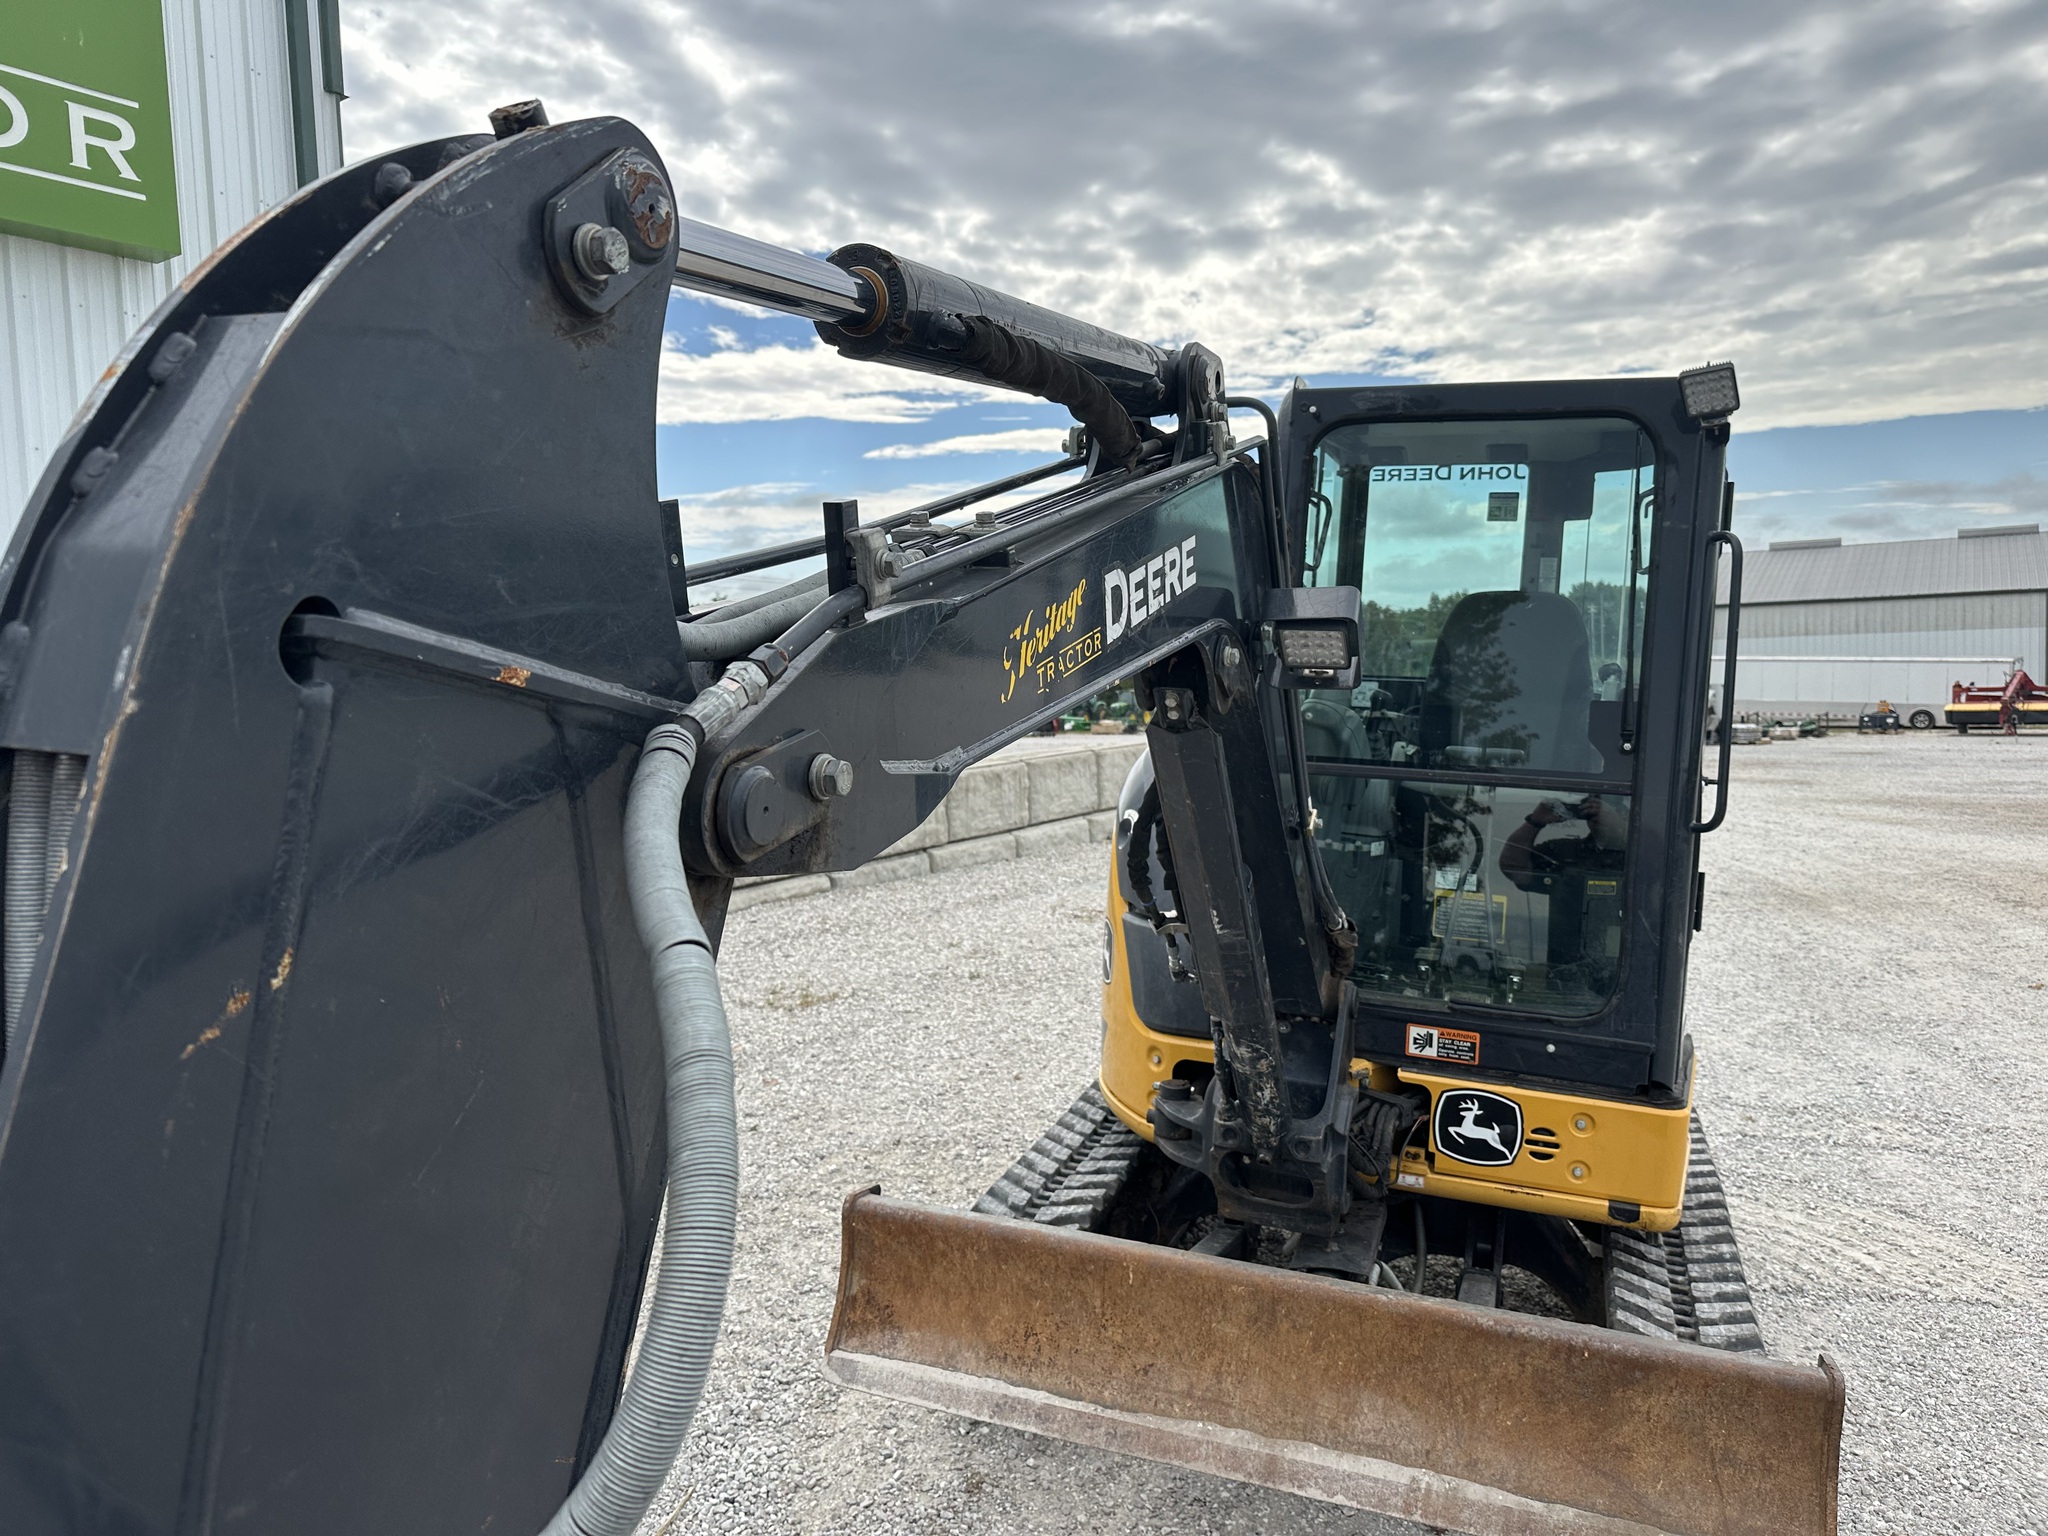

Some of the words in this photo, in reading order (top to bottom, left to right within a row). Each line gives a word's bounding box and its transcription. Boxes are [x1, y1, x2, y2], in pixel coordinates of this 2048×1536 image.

[1104, 535, 1197, 645] DEERE
[1001, 578, 1087, 703] Heritage
[1036, 632, 1101, 688] TRACTOR
[1446, 1032, 1477, 1040] WARNING
